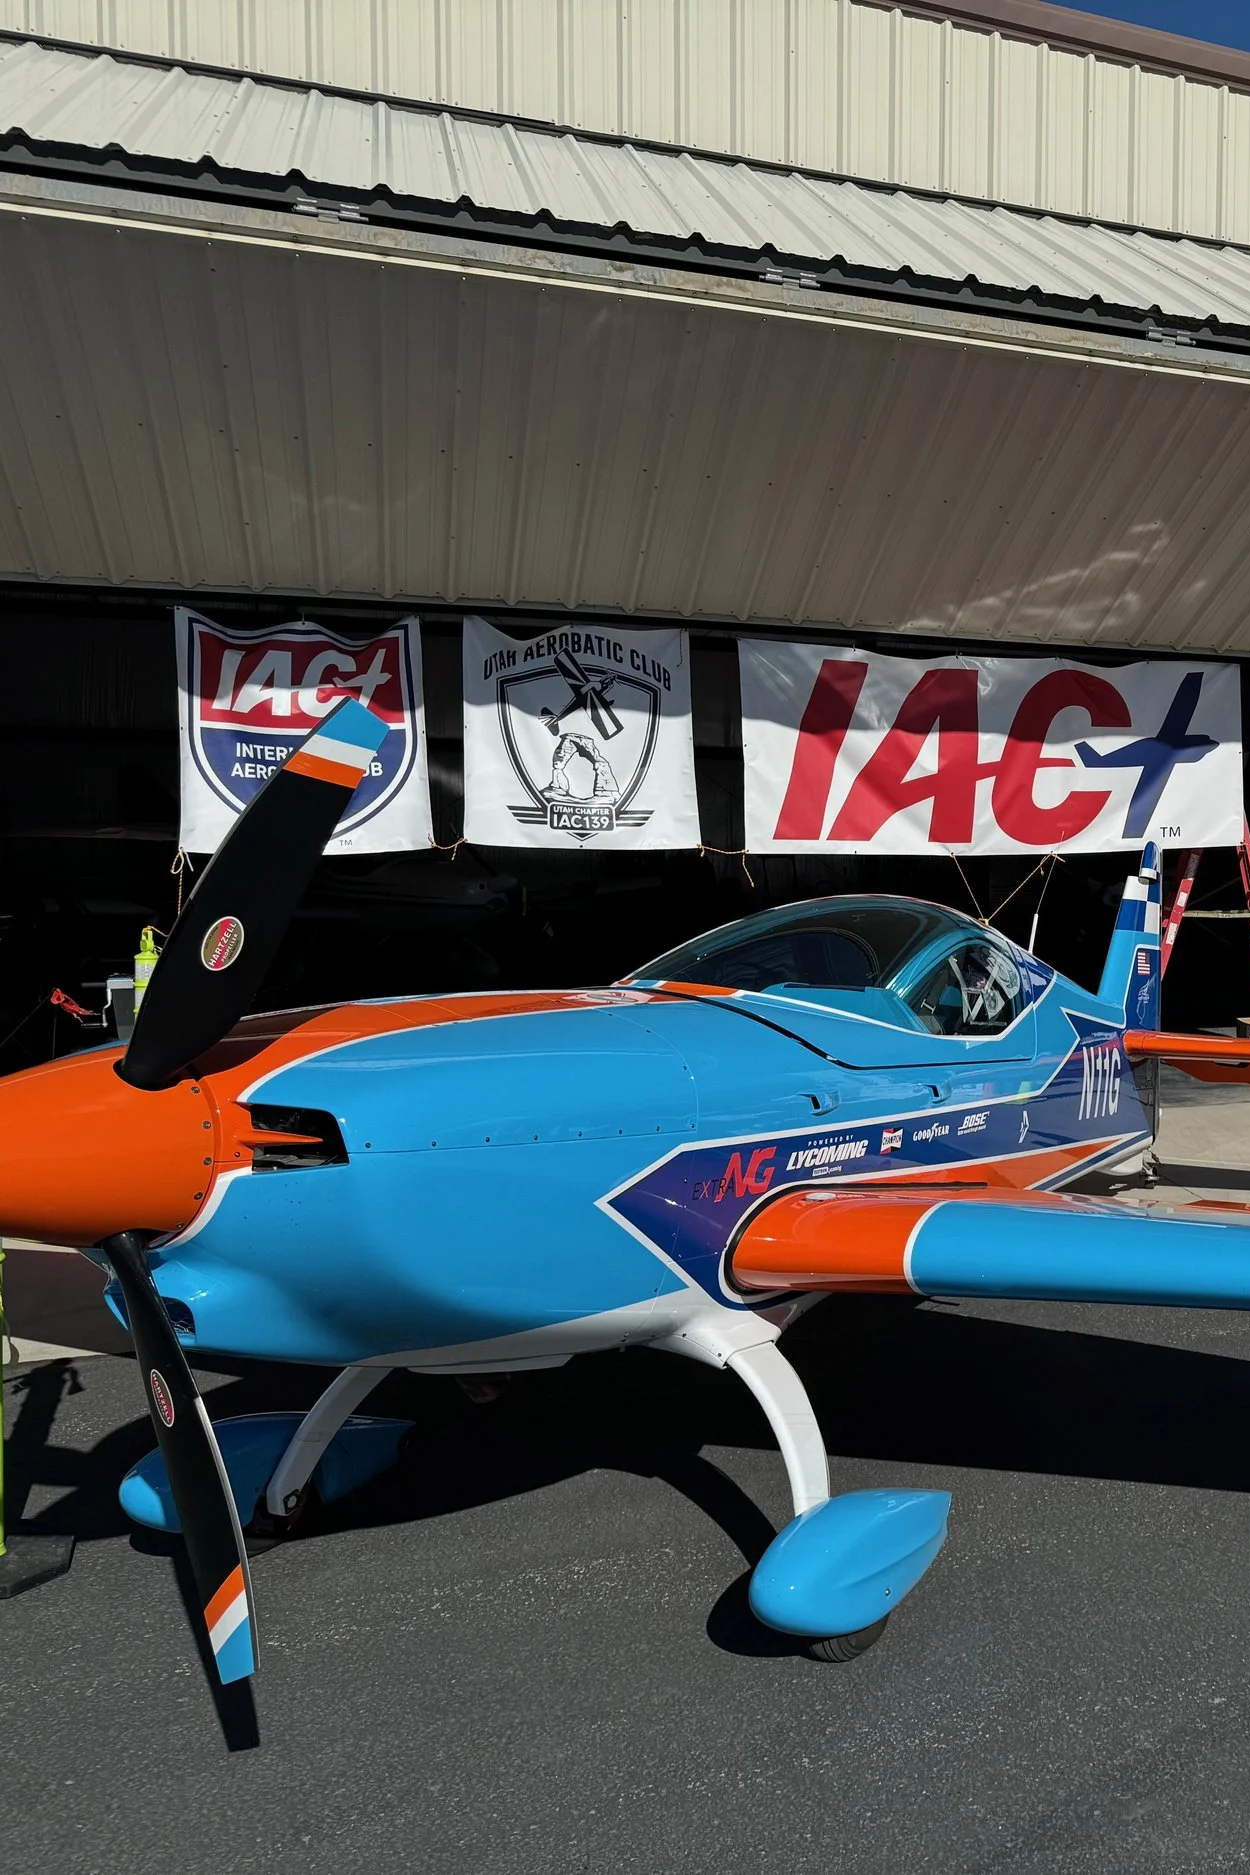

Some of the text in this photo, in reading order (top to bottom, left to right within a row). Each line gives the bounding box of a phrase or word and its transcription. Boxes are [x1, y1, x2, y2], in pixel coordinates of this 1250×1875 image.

[484, 633, 671, 691] UTAH AEROBATIC CLUB
[212, 649, 357, 717] IAC
[772, 659, 1132, 846] IAC
[553, 814, 610, 829] IAC139
[1159, 826, 1181, 838] TM
[339, 839, 353, 847] TM
[209, 922, 237, 967] HARTZELL
[221, 933, 239, 962] PROPELLER
[1078, 1046, 1121, 1121] N11G
[913, 1122, 950, 1142] GOODYEAR
[959, 1111, 990, 1128] BOSE
[786, 1139, 869, 1171] LYCOMING
[807, 1136, 843, 1147] POWERED
[693, 1146, 777, 1203] EXTRA NG
